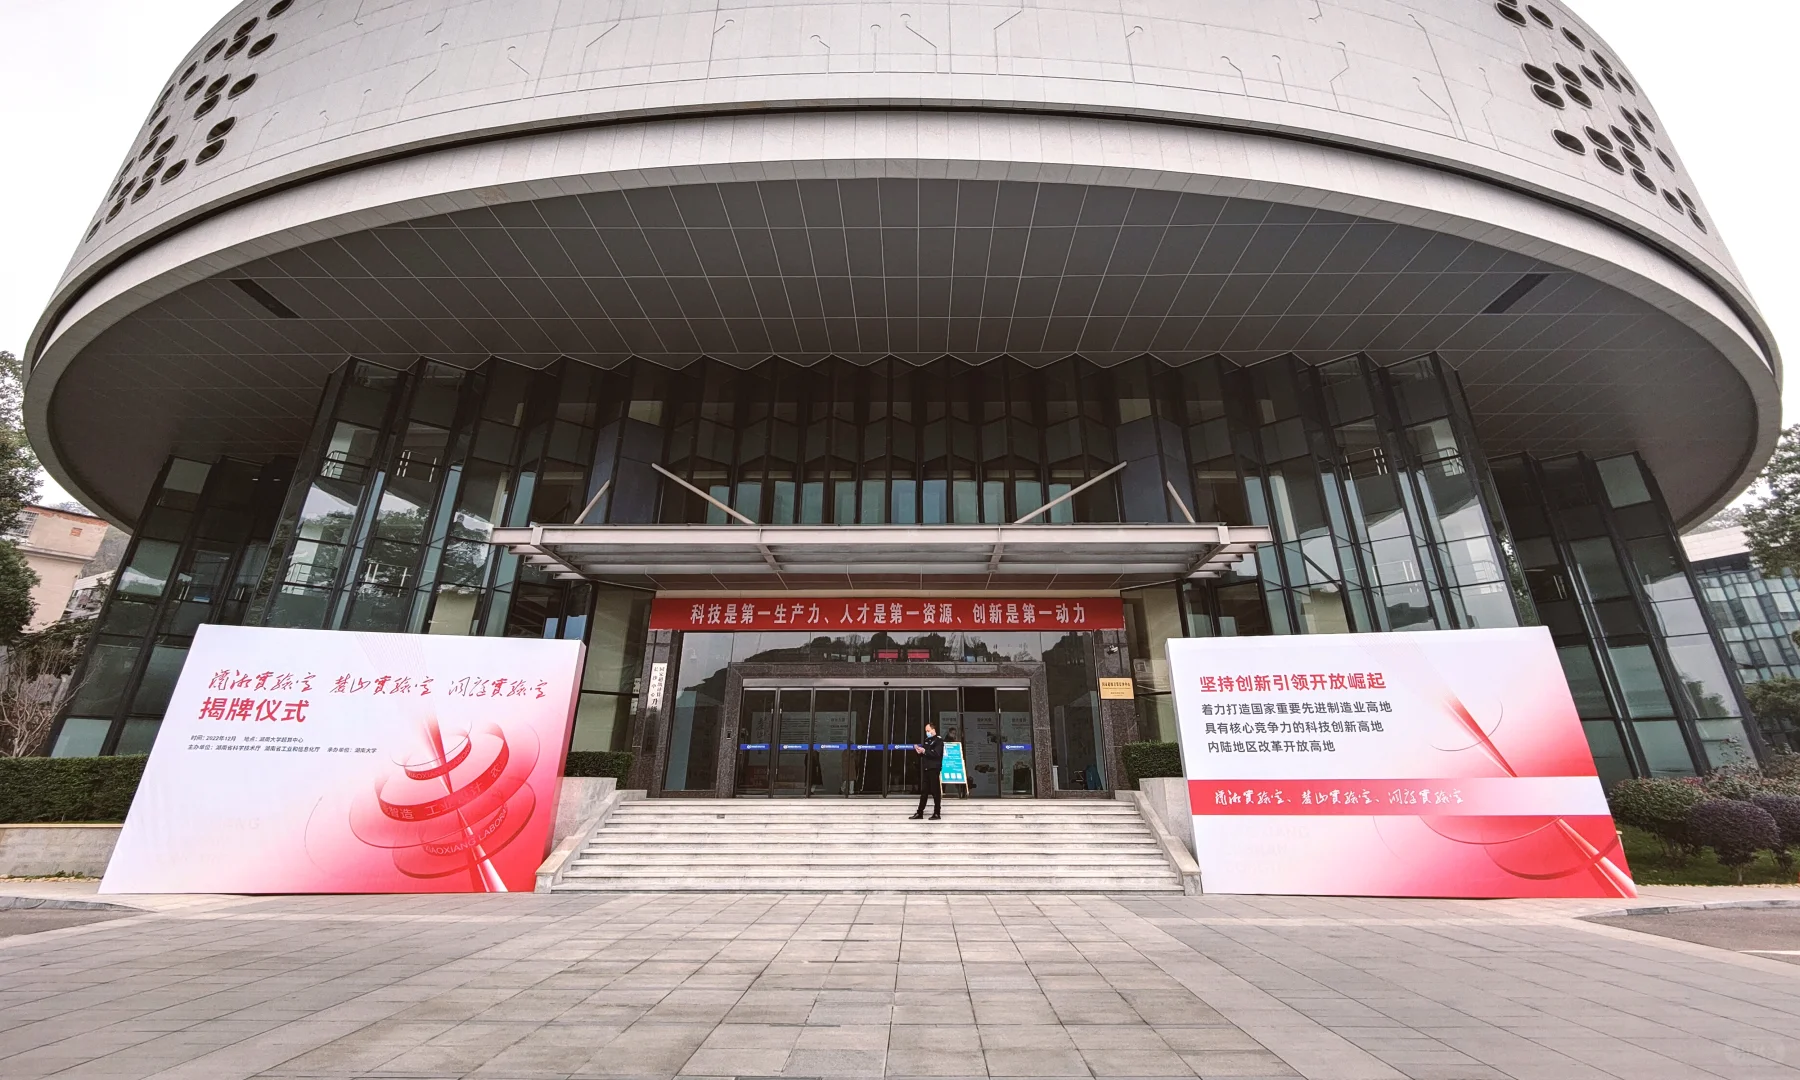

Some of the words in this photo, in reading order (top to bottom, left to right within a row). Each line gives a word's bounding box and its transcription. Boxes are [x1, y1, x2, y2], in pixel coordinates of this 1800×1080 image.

[690, 602, 1087, 625] 科技是第一生产力、人才是第一资源、创新是第一动力
[1199, 672, 1387, 693] 坚持创新引领开放崛起
[198, 696, 310, 723] 揭牌仪式
[1201, 700, 1393, 716] 着力打造国家重要先进制造业高地
[1205, 720, 1384, 735] 具有核心竞争力的科技创新高地
[1207, 739, 1336, 753] 内陆地区改革开放高地
